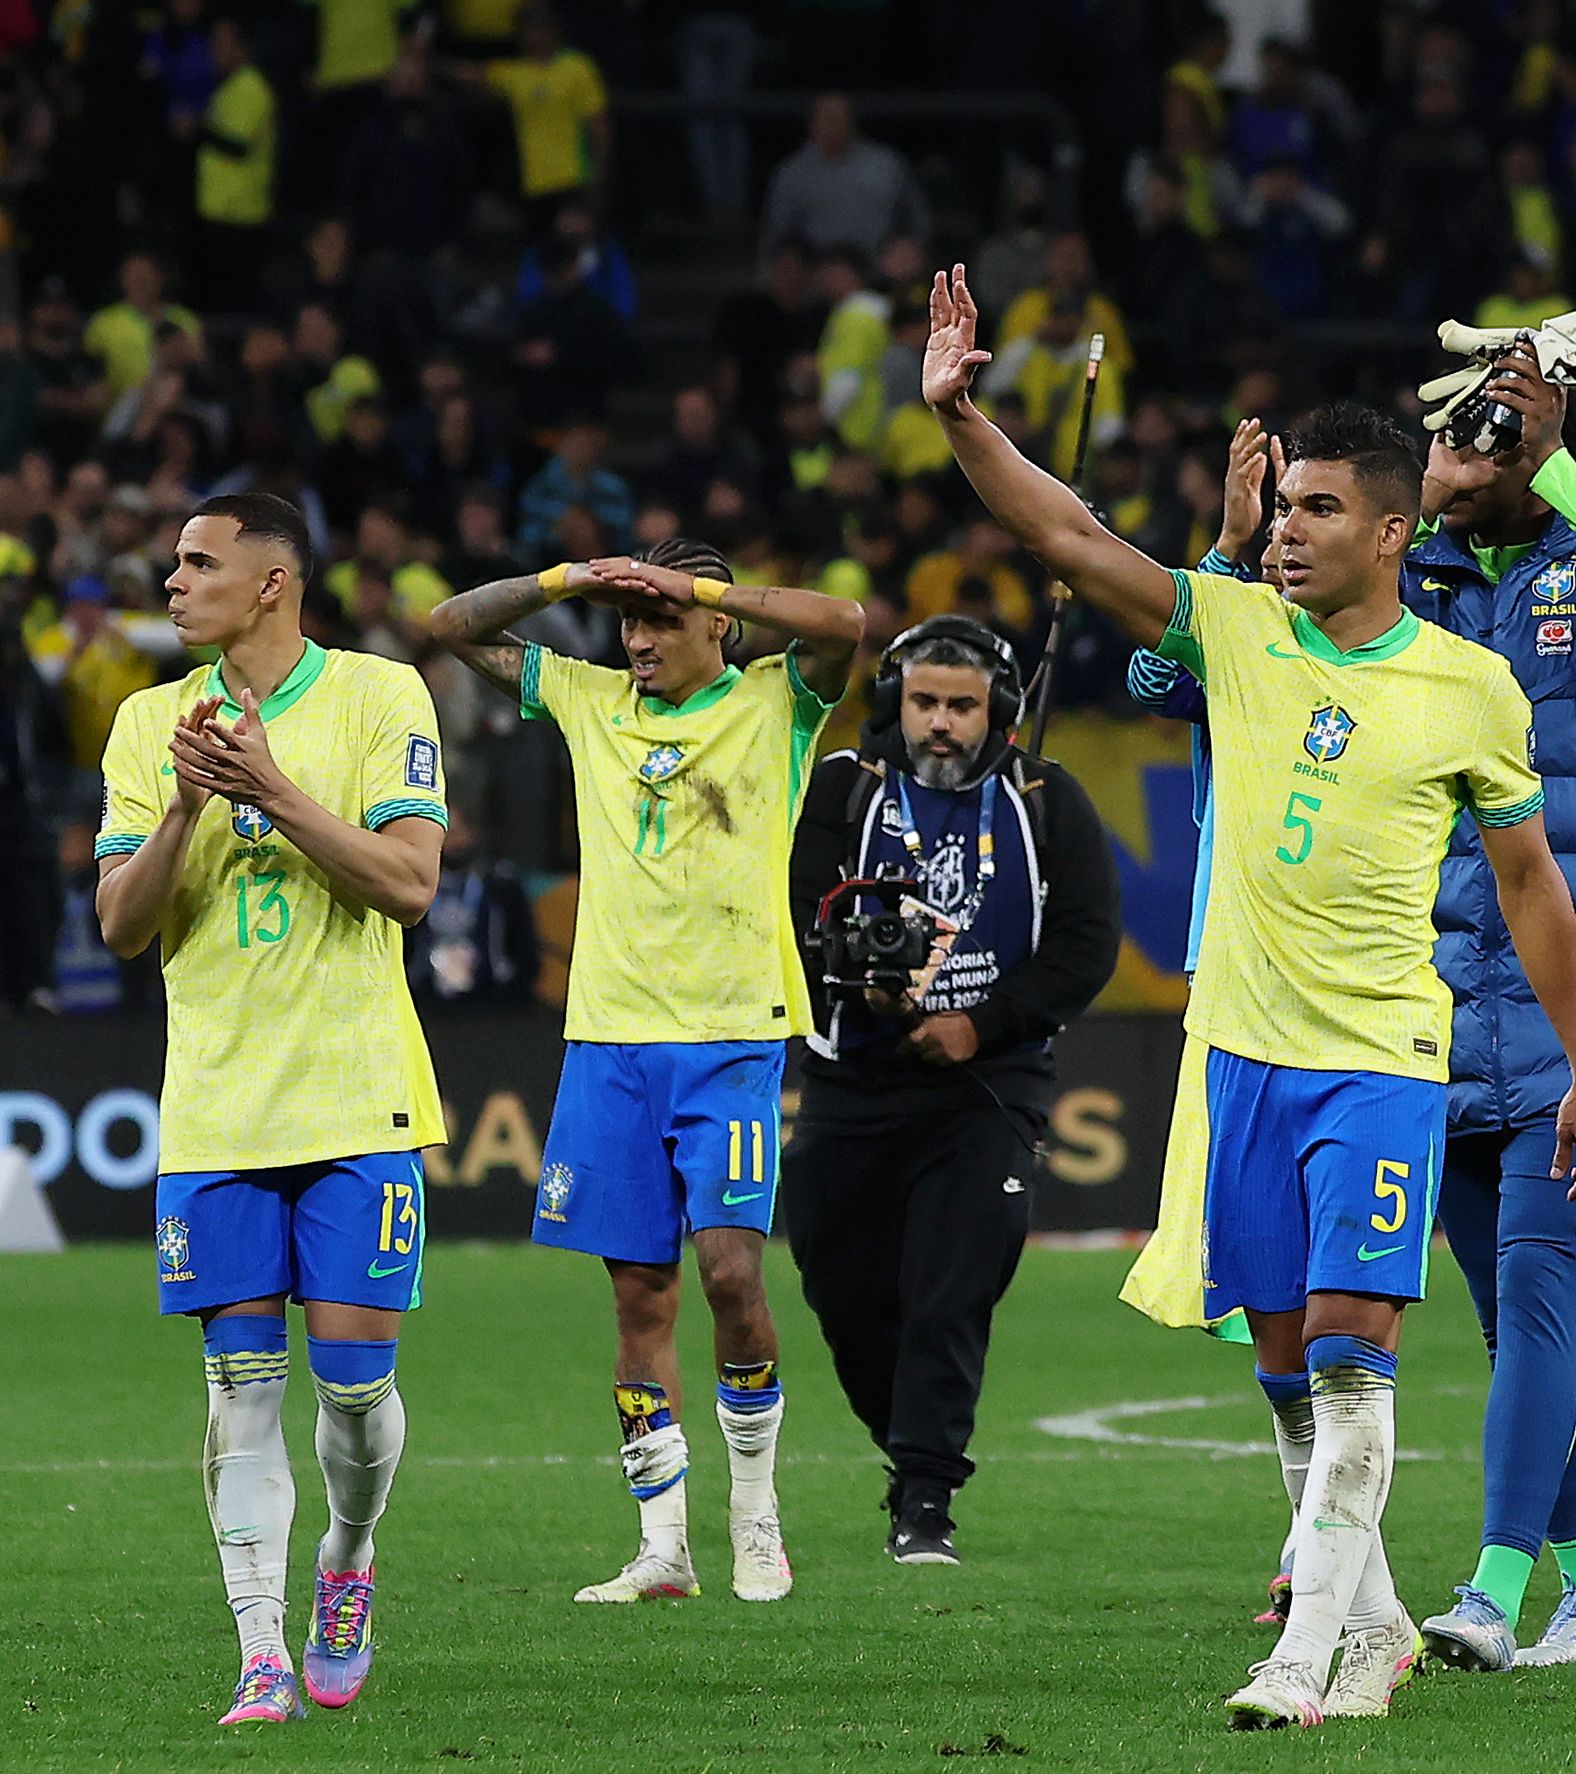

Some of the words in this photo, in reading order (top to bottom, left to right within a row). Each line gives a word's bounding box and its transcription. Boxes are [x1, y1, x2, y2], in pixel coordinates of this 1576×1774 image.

[1320, 727, 1339, 738] CBF
[1293, 761, 1341, 786] BRASIL
[234, 844, 280, 861] BRASIL
[634, 799, 667, 855] 11
[1275, 791, 1322, 865] 5
[237, 870, 290, 949] 13
[728, 1120, 764, 1184] 11
[379, 1183, 417, 1255] 13
[1370, 1159, 1410, 1233] 5
[162, 1271, 196, 1284] BRASIL
